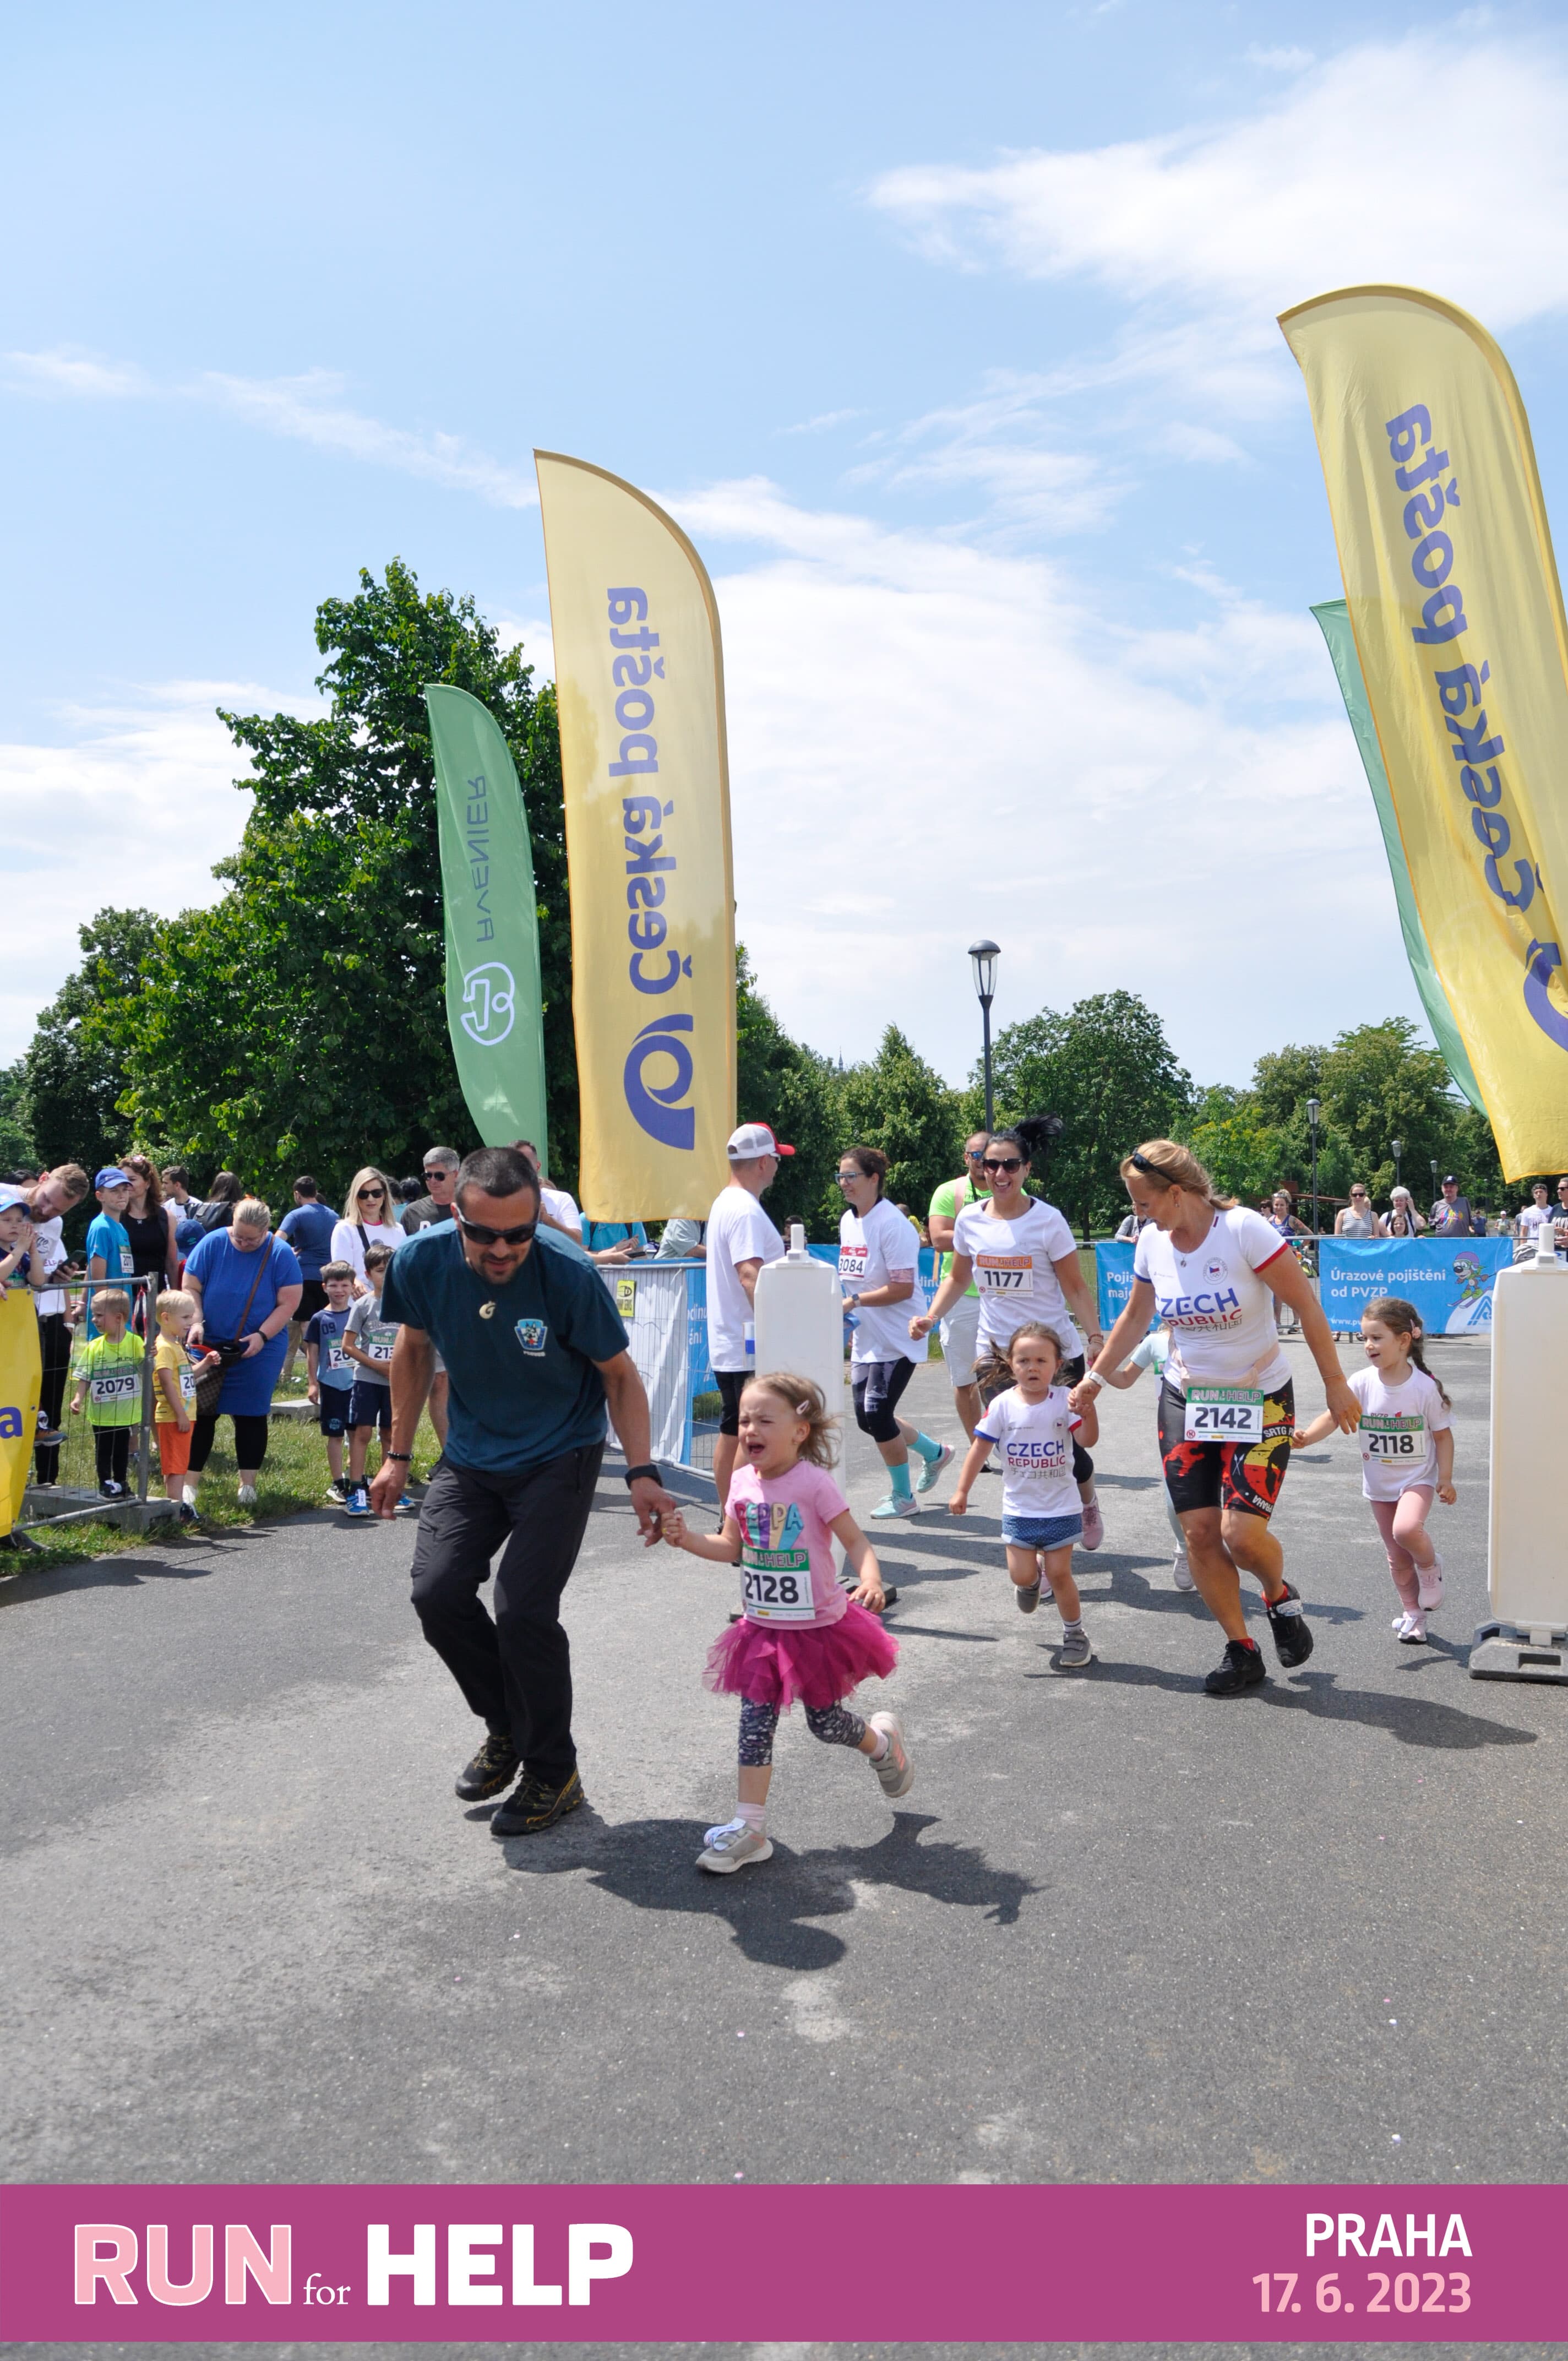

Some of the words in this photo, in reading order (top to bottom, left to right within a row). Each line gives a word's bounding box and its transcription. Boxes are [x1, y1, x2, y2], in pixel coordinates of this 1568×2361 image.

[1004, 1258, 1030, 1267] HELP
[984, 1270, 1023, 1287] 1177
[1330, 1267, 1384, 1281] Úrazové
[1388, 1269, 1446, 1283] pojištění
[1330, 1286, 1347, 1298] od
[1352, 1287, 1388, 1298] PVZP
[1156, 1287, 1240, 1318] ZECH
[322, 1322, 336, 1335] 09
[96, 1377, 135, 1395] 2079
[1191, 1389, 1219, 1401] RUN
[1226, 1390, 1261, 1403] HELP
[1194, 1407, 1252, 1429] 2142
[1391, 1418, 1421, 1429] HELP
[1264, 1426, 1287, 1438] SRTG
[1007, 1439, 1064, 1457] CZECH
[1368, 1433, 1414, 1454] 2118
[1008, 1455, 1066, 1468] REPUBLIC
[1252, 1494, 1273, 1513] PRAHA
[734, 1503, 804, 1531] PEPPA
[764, 1553, 805, 1568] HELP
[744, 1571, 799, 1604] 2128
